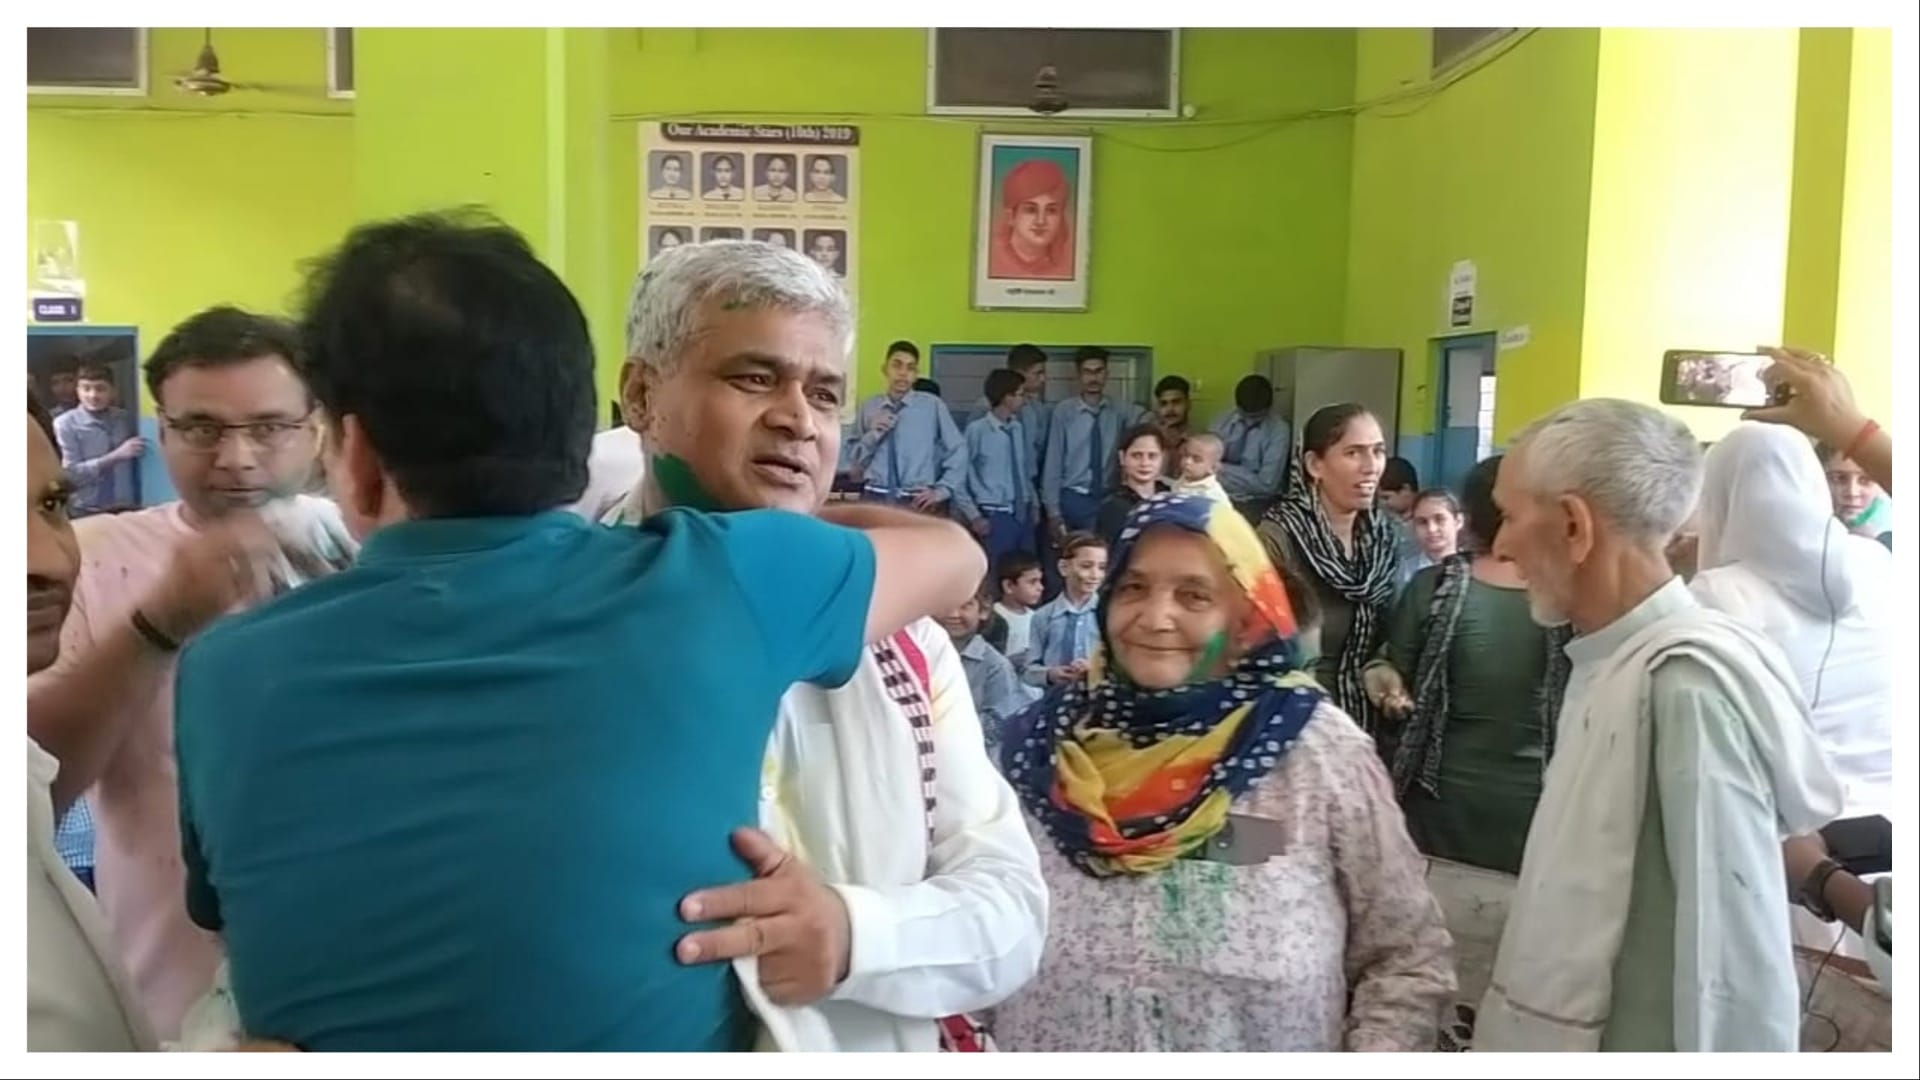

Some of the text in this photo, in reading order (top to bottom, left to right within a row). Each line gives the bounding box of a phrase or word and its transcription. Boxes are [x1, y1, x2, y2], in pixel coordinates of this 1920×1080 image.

[668, 124, 691, 136] Our
[693, 125, 750, 137] Academic
[753, 126, 783, 138] Stars
